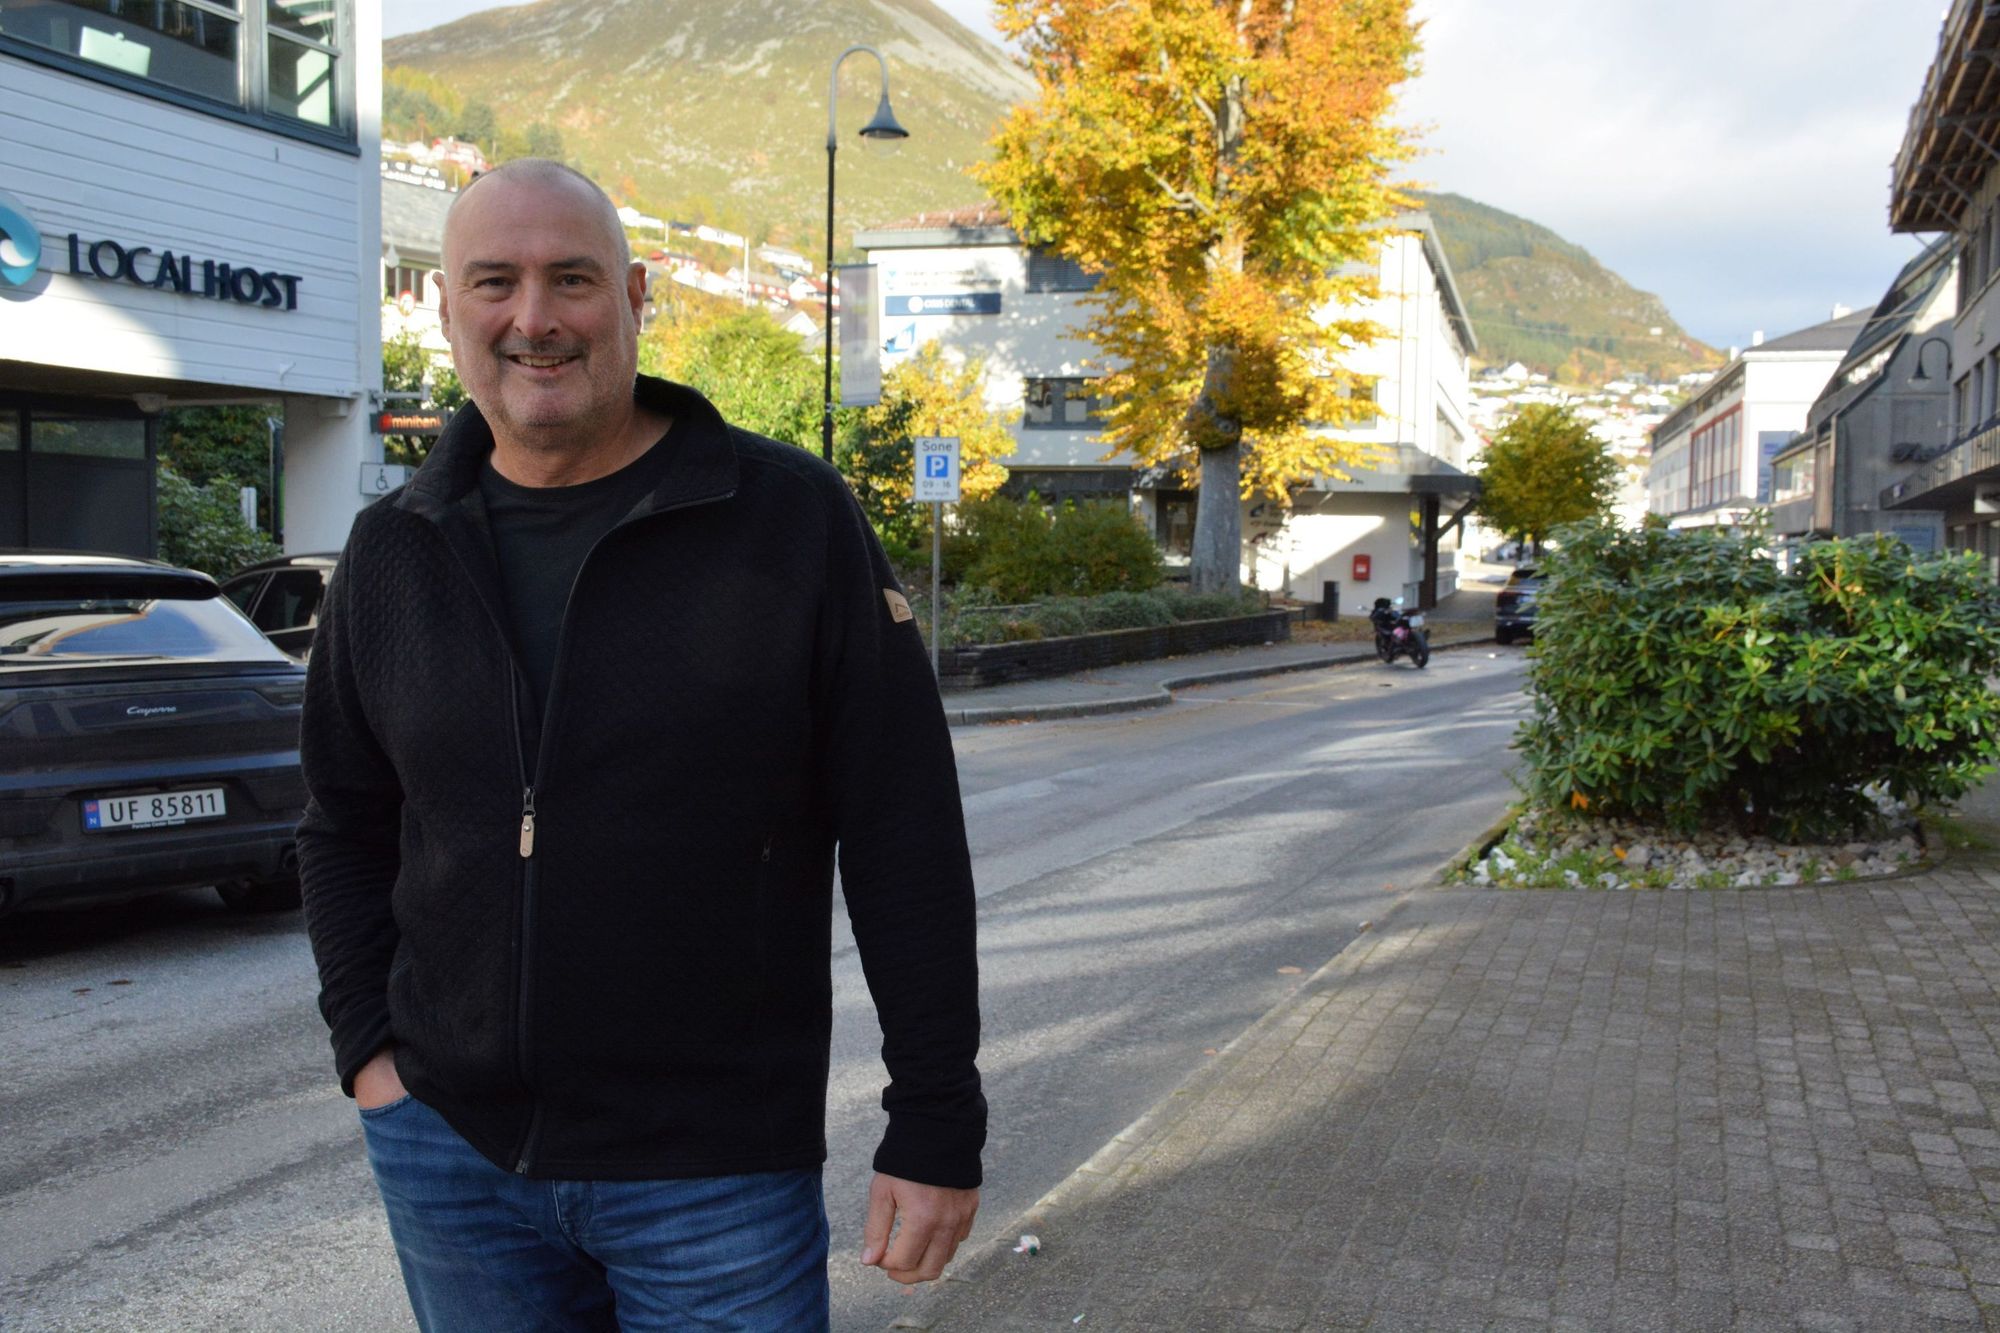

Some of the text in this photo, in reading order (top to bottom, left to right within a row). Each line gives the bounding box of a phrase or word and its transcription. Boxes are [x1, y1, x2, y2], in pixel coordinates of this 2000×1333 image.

[68, 233, 303, 310] LOCALHOST
[922, 440, 952, 451] Sone
[931, 456, 945, 477] P
[126, 706, 177, 716] Cayenne
[110, 793, 217, 823] UF 85811
[89, 816, 98, 825] N
